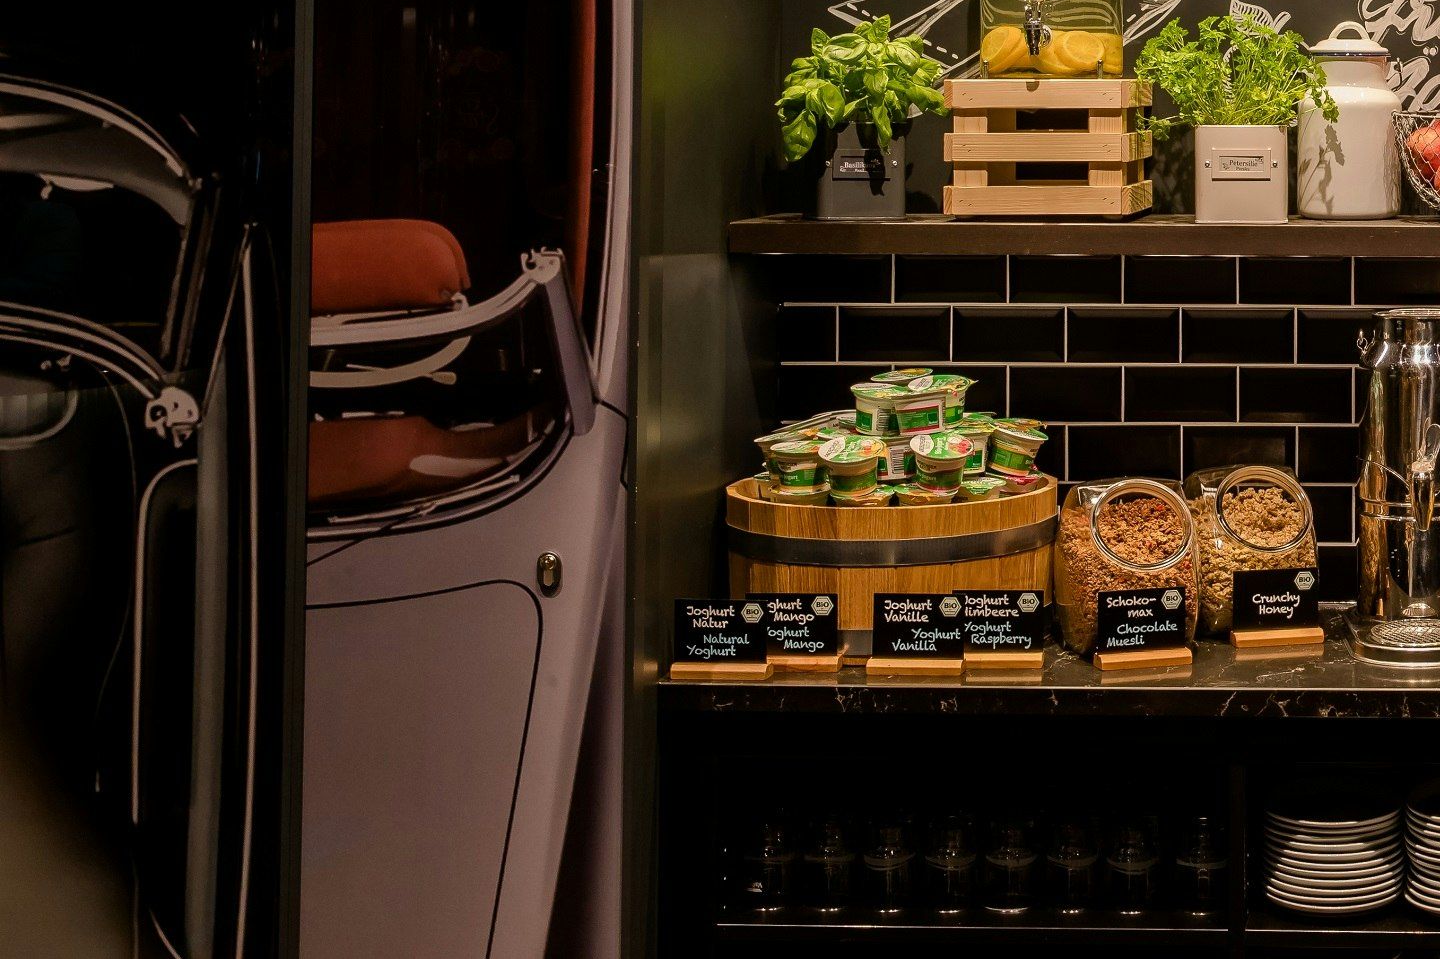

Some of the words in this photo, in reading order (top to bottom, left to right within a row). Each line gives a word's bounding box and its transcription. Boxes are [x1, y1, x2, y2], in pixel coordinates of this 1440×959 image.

[767, 598, 803, 613] ghurt
[884, 599, 933, 614] Joghurt
[1106, 595, 1157, 608] Schoko-
[1252, 592, 1301, 608] Crunchy
[686, 604, 736, 620] Joghurt
[773, 611, 815, 626] Mango
[884, 610, 930, 623] Vanille
[1127, 607, 1154, 619] max
[1258, 603, 1294, 620] Honey
[692, 618, 729, 629] Natur
[964, 621, 1012, 636] Yoghurt
[1116, 619, 1179, 635] Chocolate
[703, 632, 750, 645] Natural
[767, 626, 810, 641] oghurt
[911, 627, 961, 643] Yoghurt
[970, 631, 1032, 649] Raspberry
[1106, 634, 1145, 648] Muesli
[686, 644, 737, 659] Yoghurt
[783, 639, 825, 652] Mango
[891, 639, 938, 652] Vanilla
